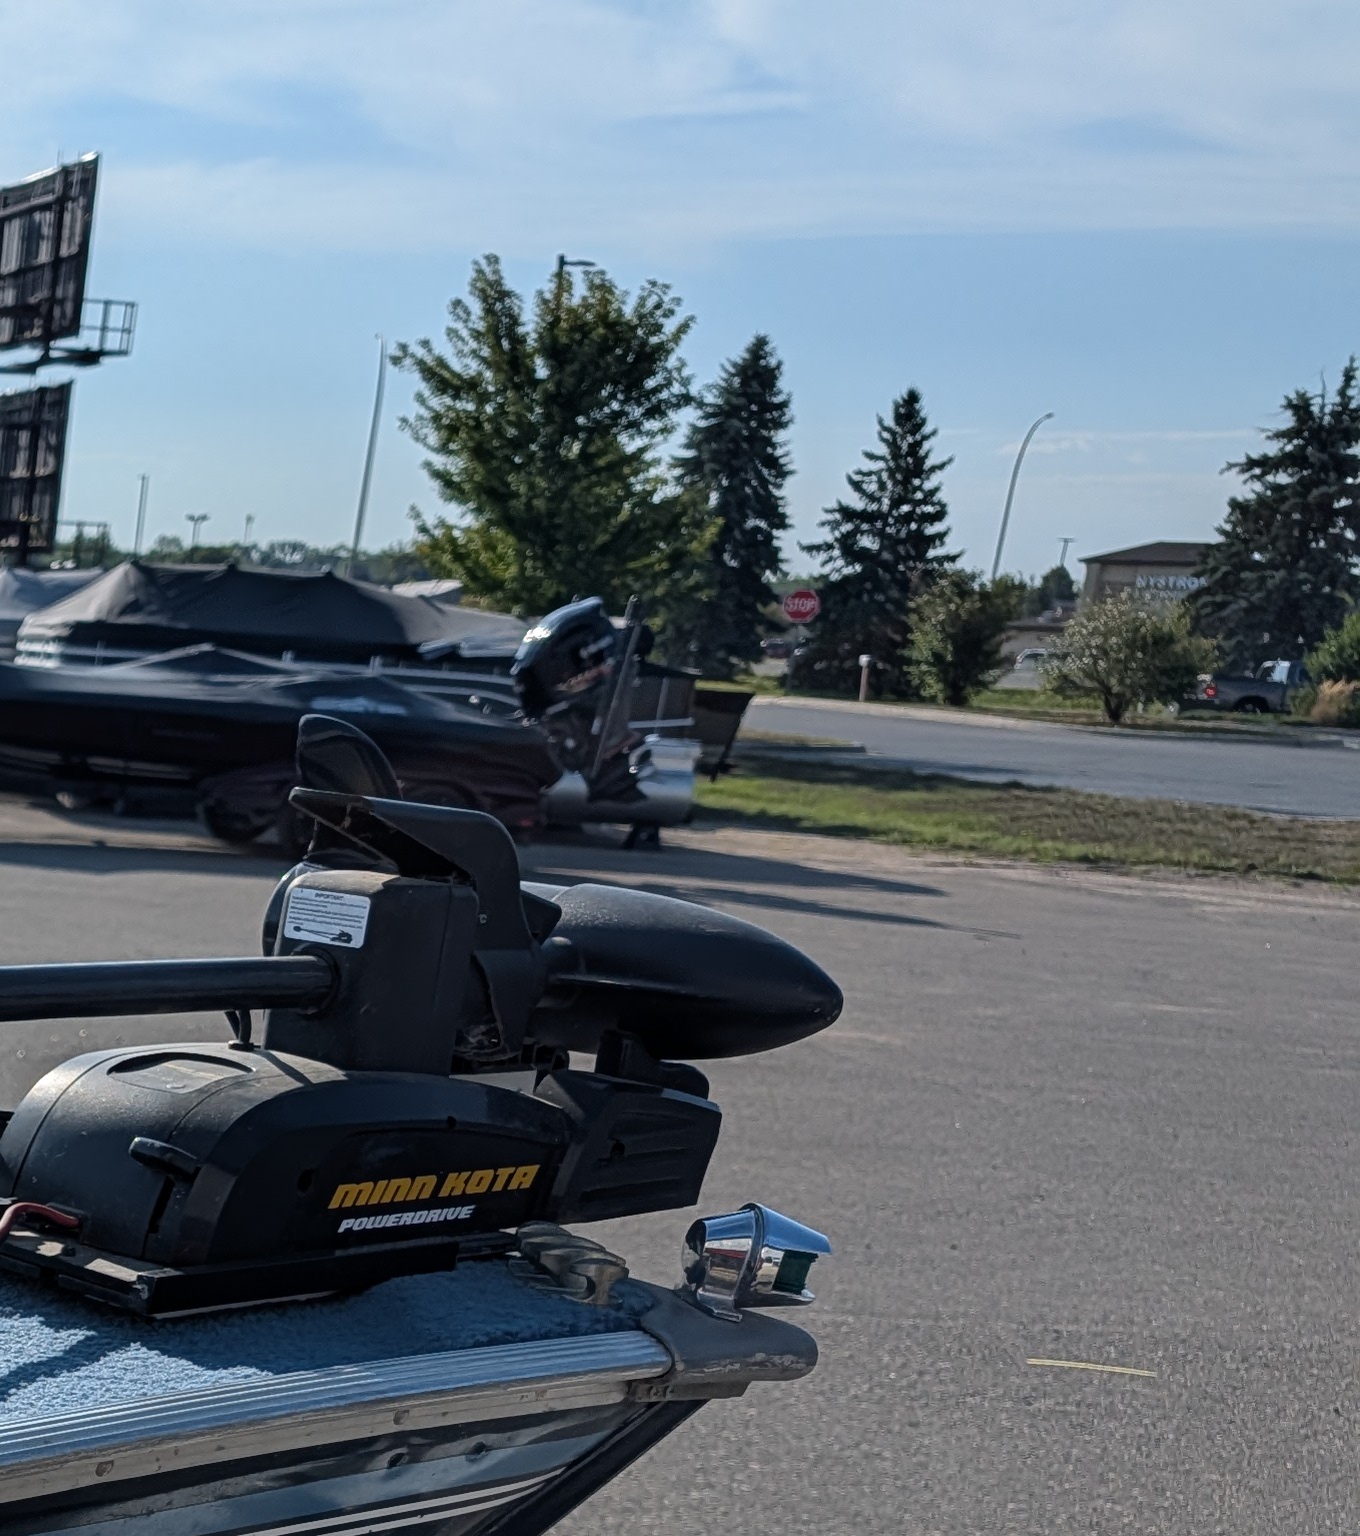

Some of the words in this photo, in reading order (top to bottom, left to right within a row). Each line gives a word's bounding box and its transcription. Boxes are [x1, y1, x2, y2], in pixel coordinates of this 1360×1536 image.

[785, 597, 817, 612] STOP
[328, 1174, 438, 1210] MINN
[437, 1164, 541, 1198] KOTA
[337, 1204, 477, 1234] POWERDRIVE
